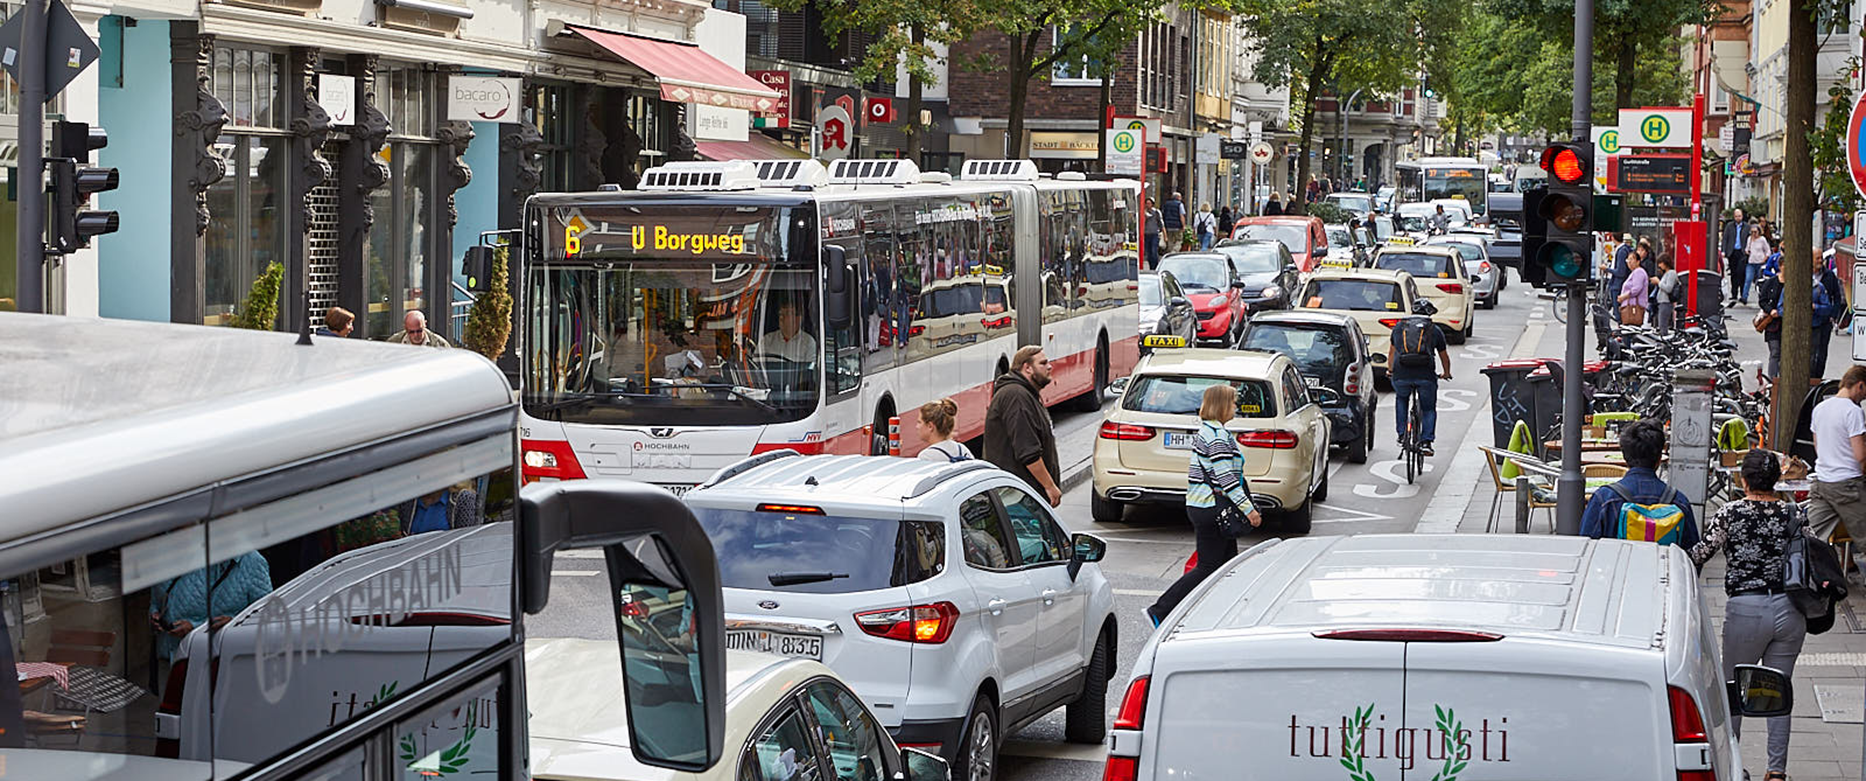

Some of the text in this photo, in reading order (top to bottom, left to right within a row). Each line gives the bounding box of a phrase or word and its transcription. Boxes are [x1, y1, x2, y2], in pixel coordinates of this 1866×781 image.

[761, 73, 784, 84] Casa
[455, 86, 501, 102] bacaro
[565, 225, 744, 254] 6 U Borgweg
[1151, 337, 1178, 346] TAXI
[644, 442, 690, 450] HOCHBAHN
[1171, 433, 1186, 446] HH
[299, 543, 462, 666] HOCHBAHN
[1287, 714, 1511, 770] tuttigusti
